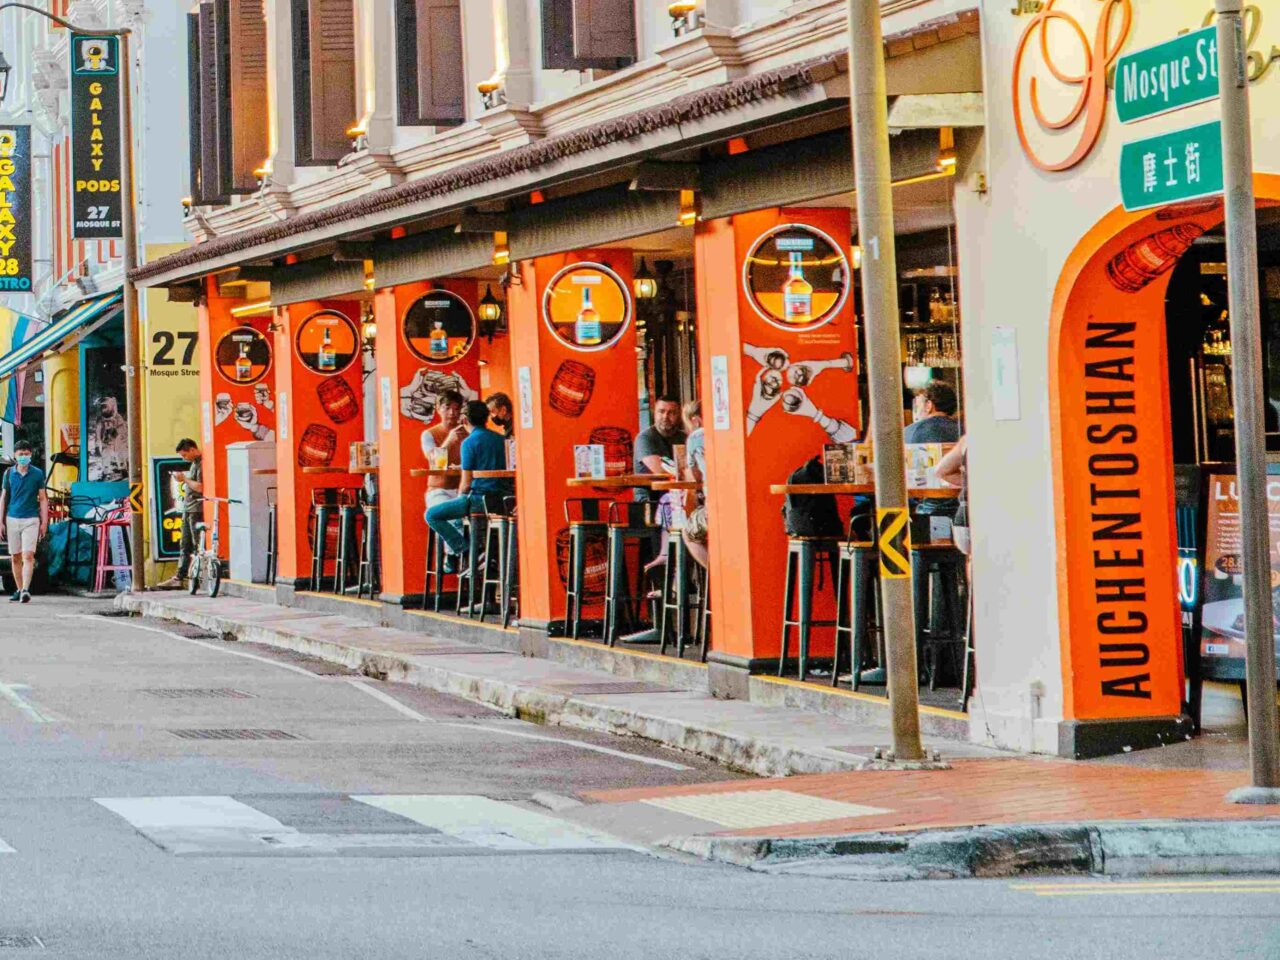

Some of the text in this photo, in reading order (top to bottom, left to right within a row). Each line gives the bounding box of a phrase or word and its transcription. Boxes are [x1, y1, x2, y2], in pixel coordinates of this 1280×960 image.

[1123, 56, 1191, 103] Mosque
[89, 82, 104, 172] GALAXY
[76, 180, 120, 192] PODS
[76, 220, 110, 228] MOSQUE
[87, 206, 110, 219] 27
[152, 331, 199, 366] 27
[150, 369, 179, 378] Mosque
[1085, 322, 1152, 700] AUCHENTOSHAN
